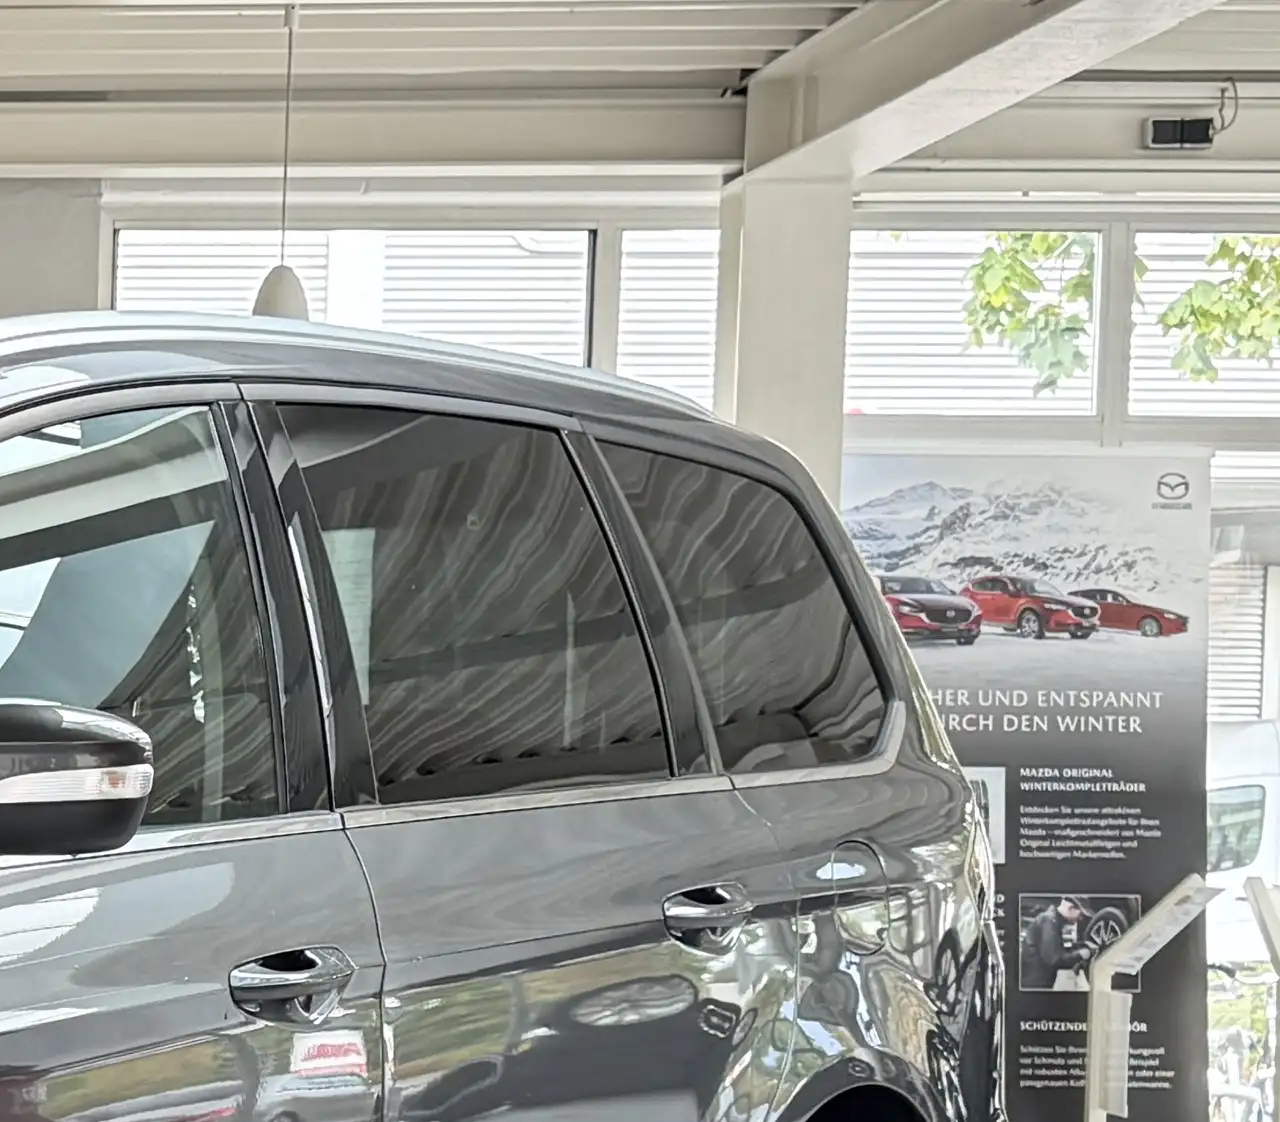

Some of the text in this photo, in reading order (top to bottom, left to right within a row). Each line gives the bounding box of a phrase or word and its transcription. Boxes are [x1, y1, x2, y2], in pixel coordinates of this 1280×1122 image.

[978, 690, 1028, 706] UND
[1037, 691, 1163, 708] ENTSPANNT
[1002, 714, 1048, 732] DEN
[1056, 715, 1143, 733] WINTER
[1020, 767, 1114, 778] MAZDA ORIGINAL
[1020, 781, 1146, 792] WINTERKOMPLETTRÄDER
